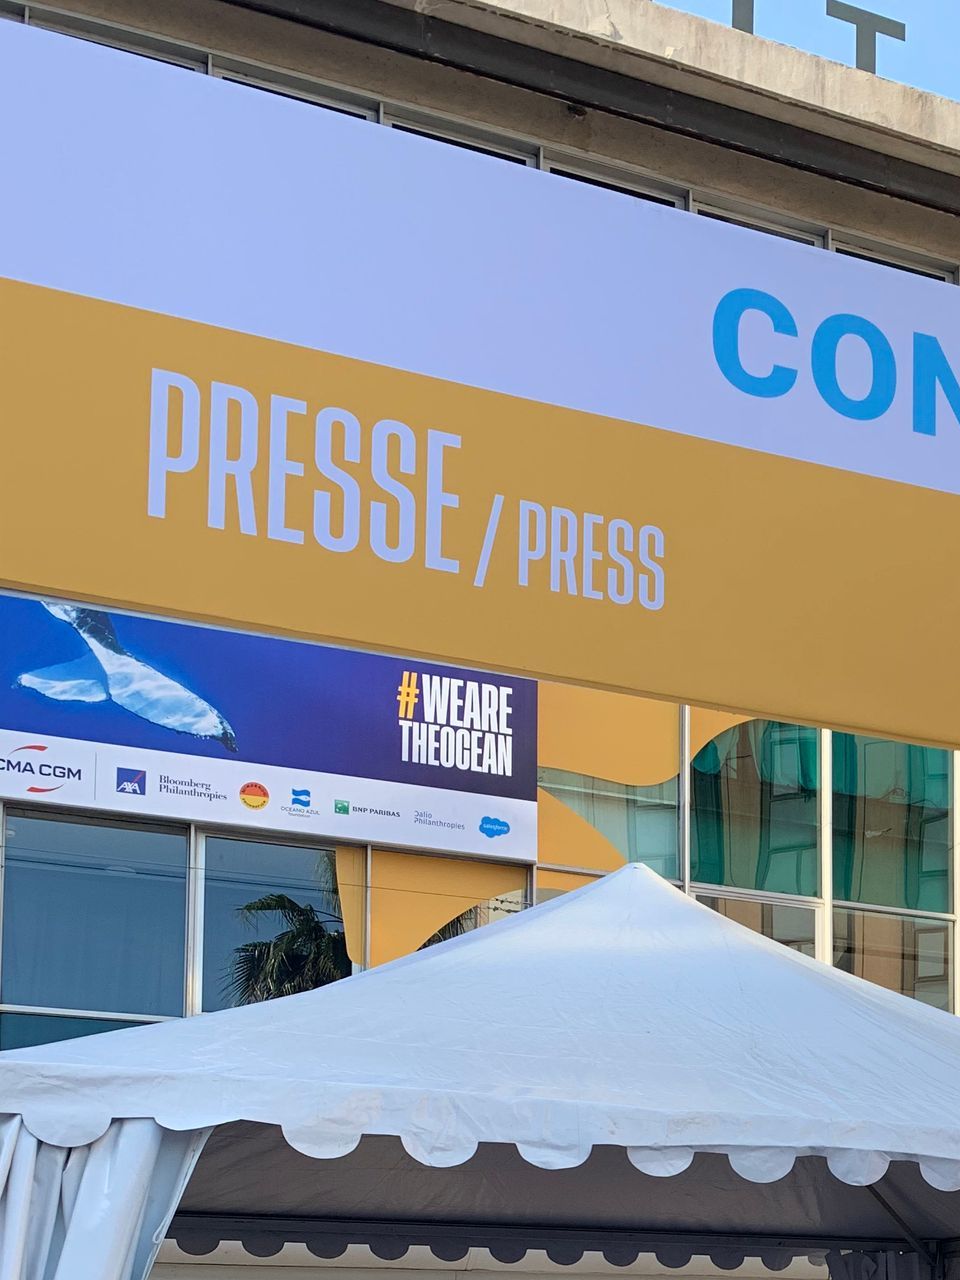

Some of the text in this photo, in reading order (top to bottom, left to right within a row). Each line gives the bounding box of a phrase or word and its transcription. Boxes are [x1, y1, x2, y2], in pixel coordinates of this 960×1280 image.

[147, 367, 665, 611] PRESSE / PRESS
[397, 671, 513, 735] #WEARE
[399, 720, 513, 777] THEOCEAN
[39, 764, 82, 781] CGM
[117, 781, 141, 794] AXA
[159, 774, 212, 791] Bloomberg
[159, 784, 228, 801] Philanthropies
[352, 806, 401, 817] BNP PARIBAS
[414, 817, 466, 830] Philanthropies
